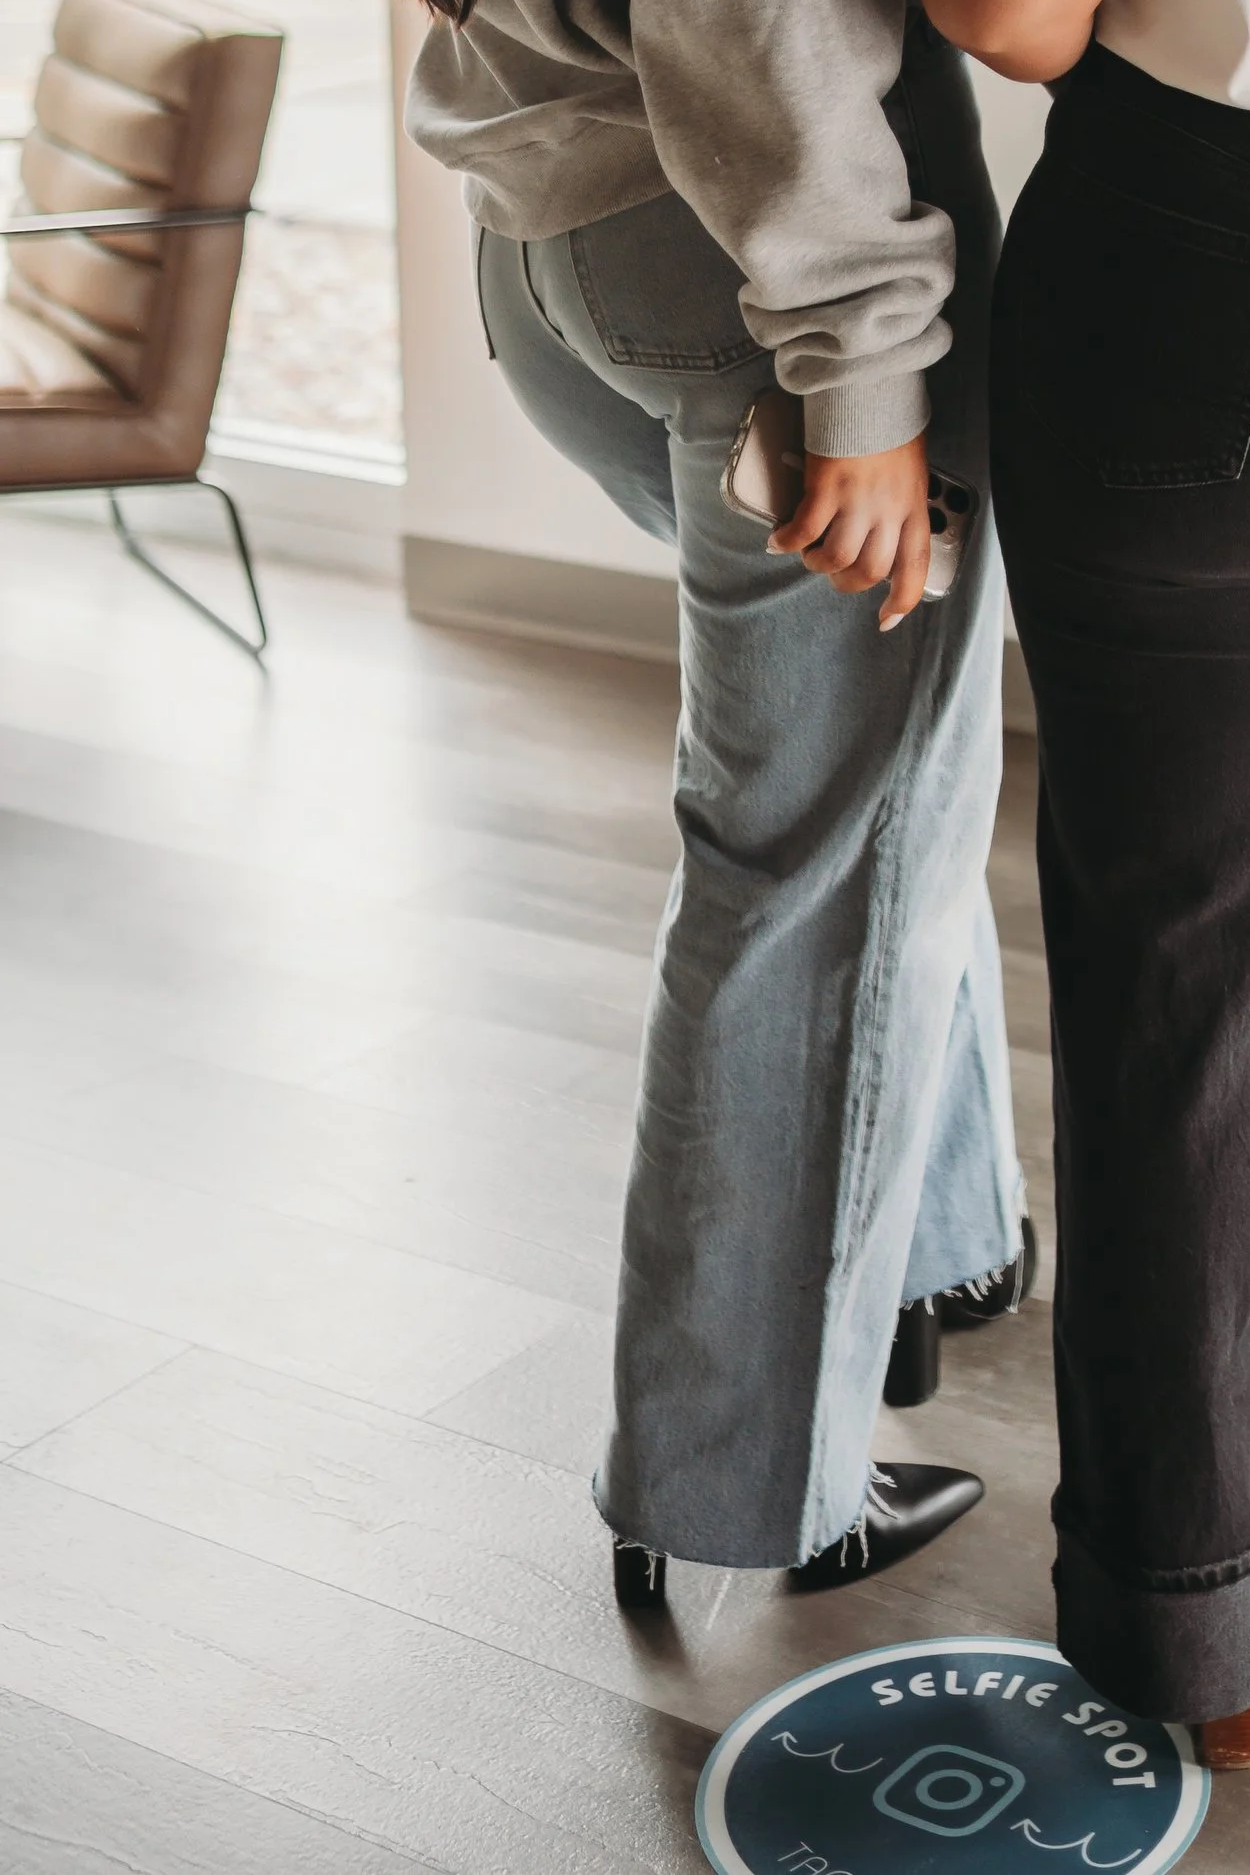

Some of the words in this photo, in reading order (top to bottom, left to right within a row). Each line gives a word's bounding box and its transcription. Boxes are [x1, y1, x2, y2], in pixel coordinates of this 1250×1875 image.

[870, 1669, 1060, 1707] SELFIE
[1061, 1700, 1157, 1790] SPOT
[776, 1840, 854, 1875] TA
